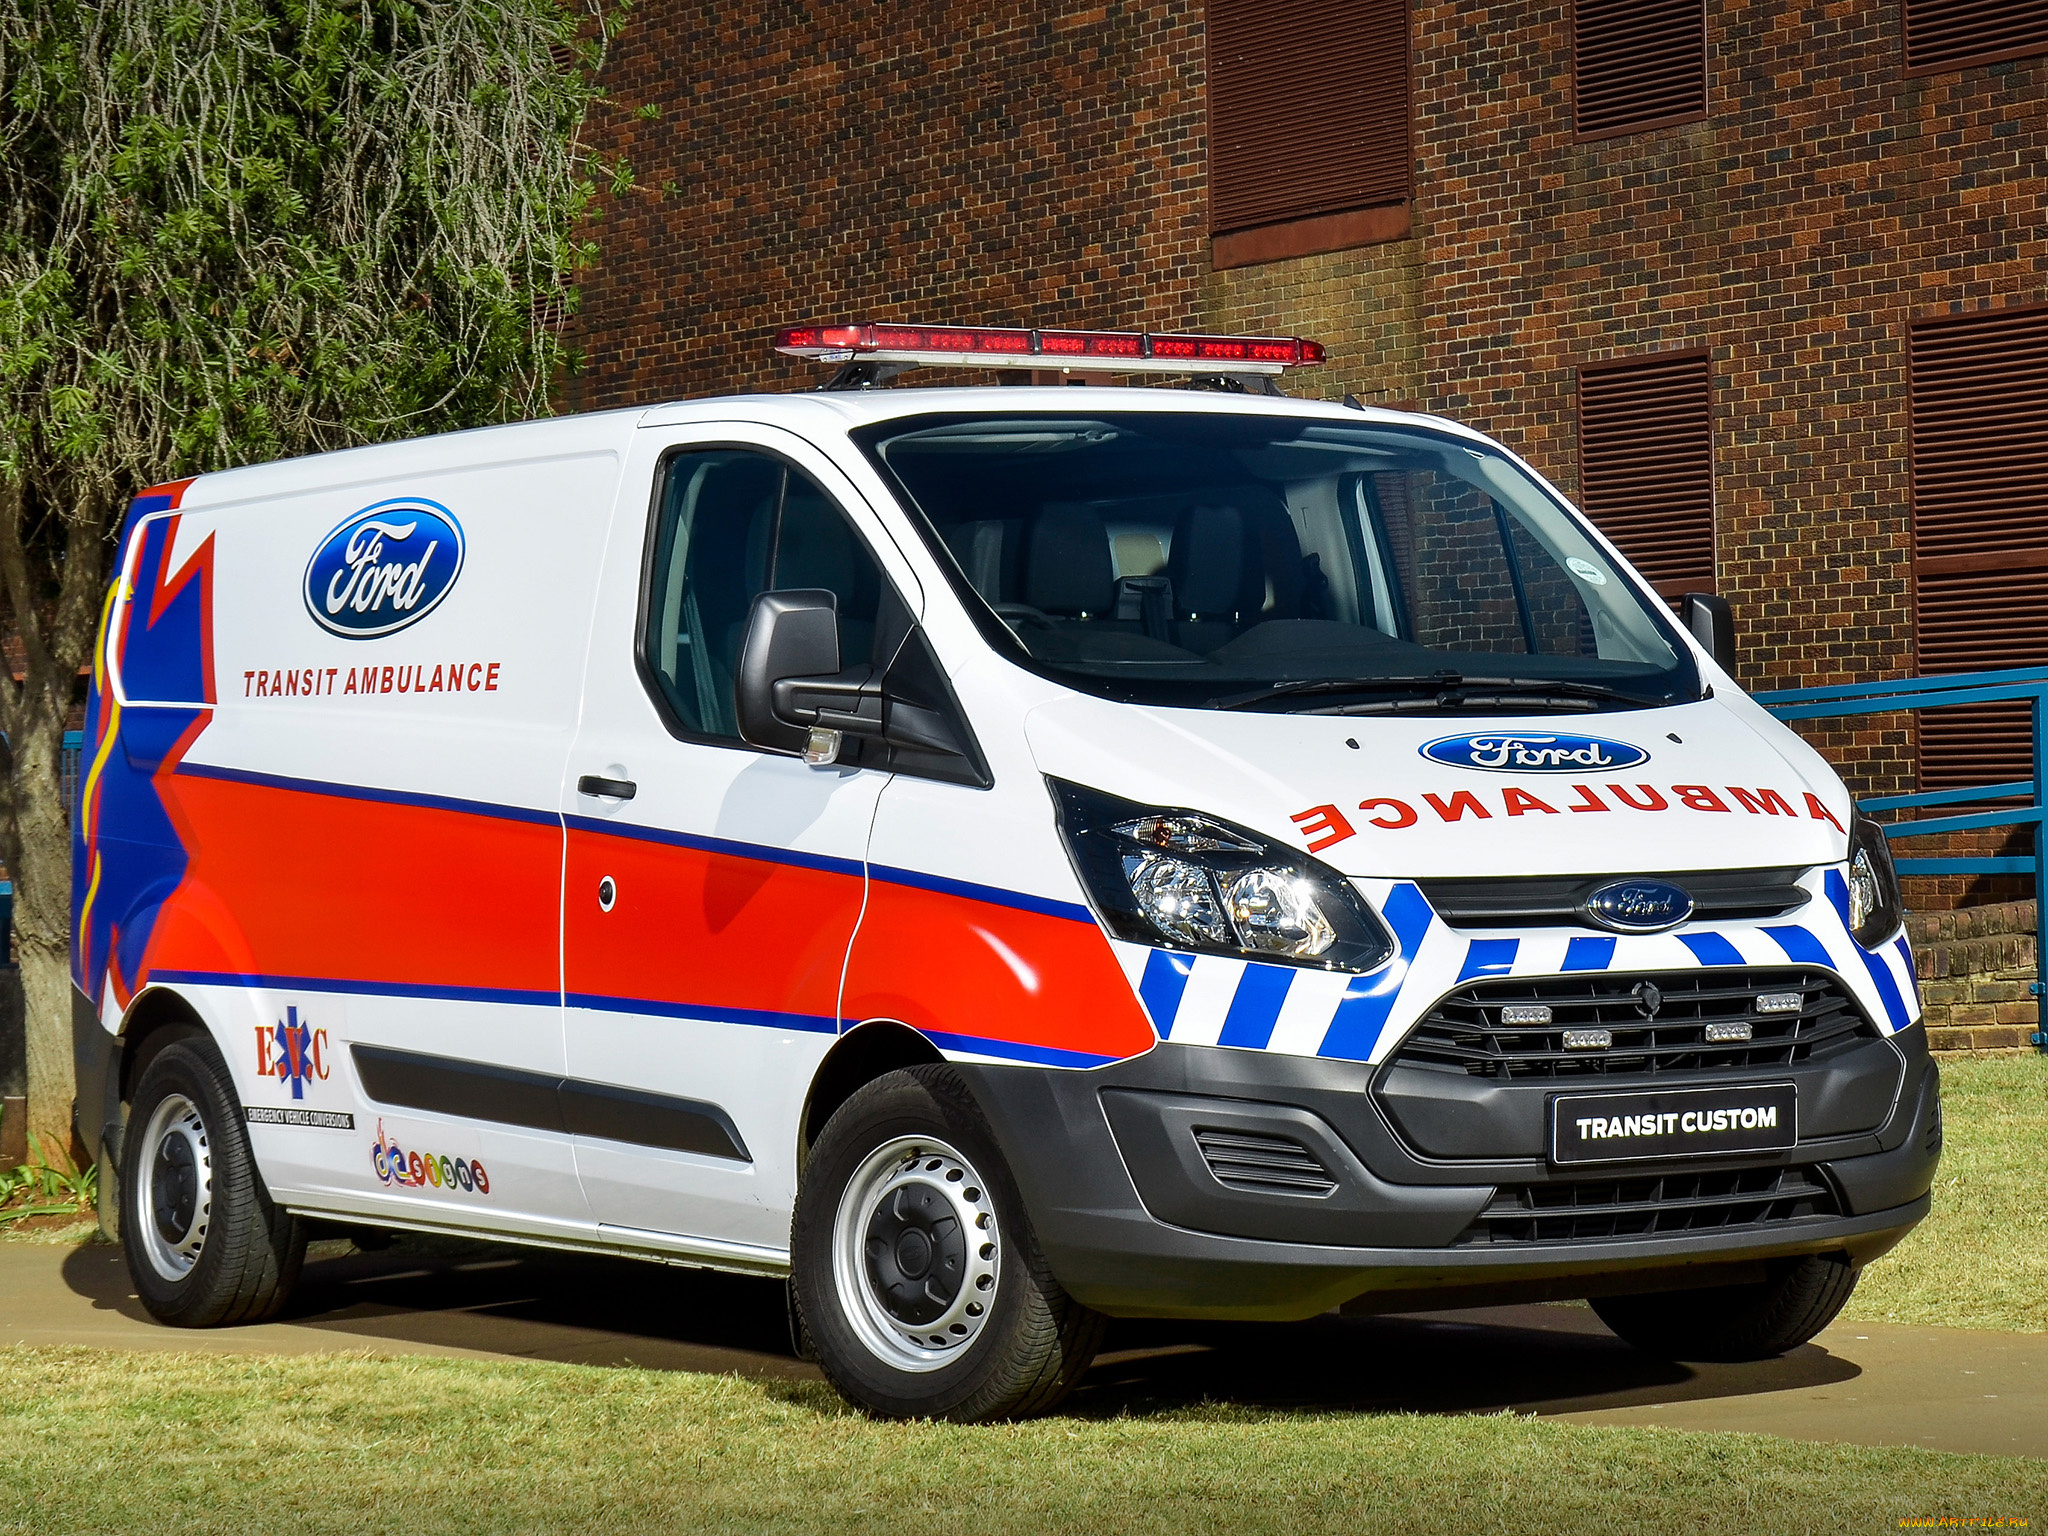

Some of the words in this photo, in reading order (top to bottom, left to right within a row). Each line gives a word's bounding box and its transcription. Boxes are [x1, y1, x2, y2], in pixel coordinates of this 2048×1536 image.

[326, 520, 438, 615] Ford
[243, 668, 338, 697] TRANSIT
[344, 662, 501, 695] AMBULANCE
[1468, 736, 1612, 767] Ford
[1617, 887, 1673, 917] Ford
[248, 1108, 285, 1122] EMERGENCY
[284, 1110, 310, 1125] VEHICLE
[310, 1112, 350, 1128] CONVERSIONS
[1576, 1112, 1679, 1140] TRANSIT
[1681, 1106, 1777, 1132] CUSTOM
